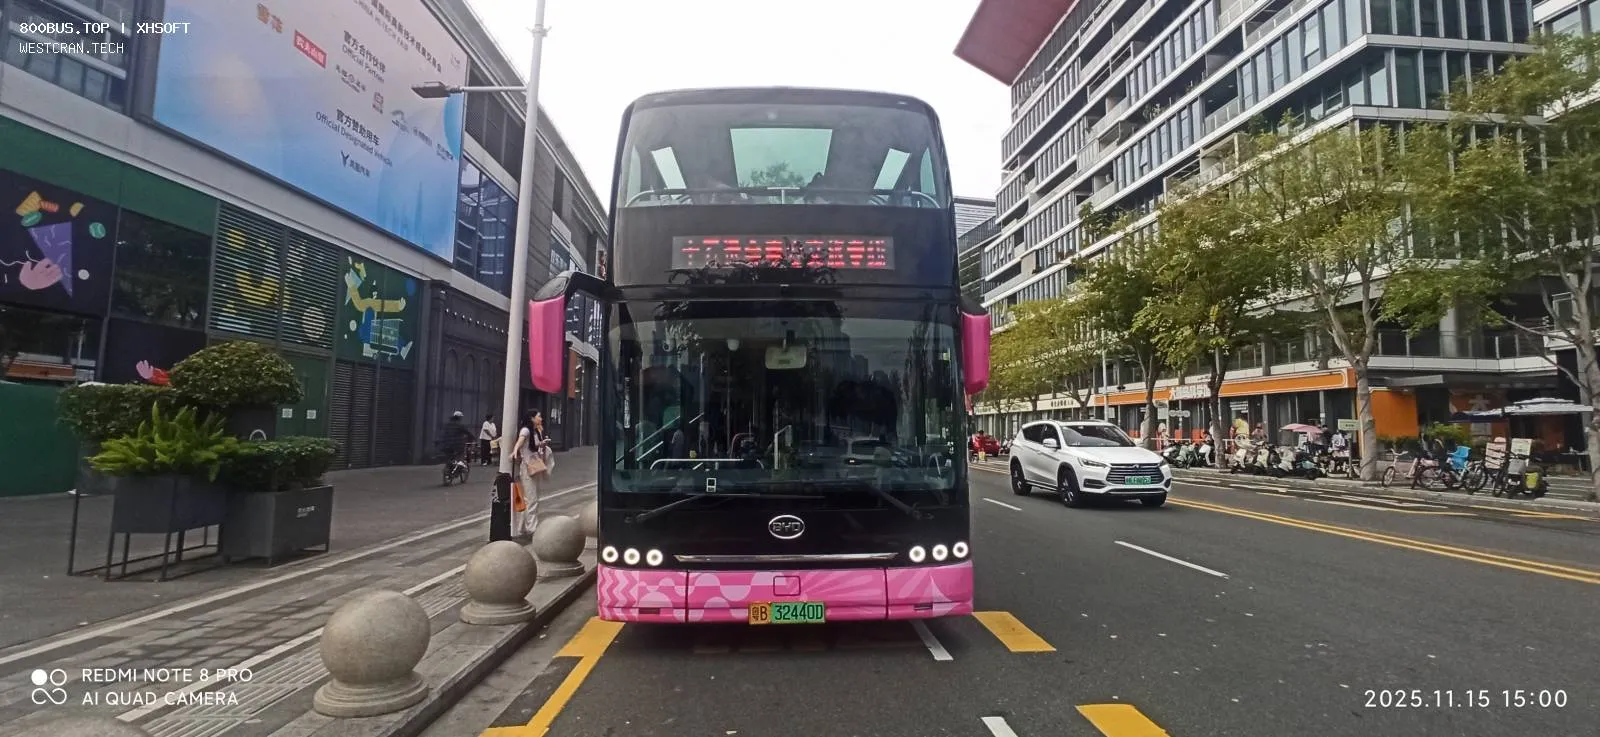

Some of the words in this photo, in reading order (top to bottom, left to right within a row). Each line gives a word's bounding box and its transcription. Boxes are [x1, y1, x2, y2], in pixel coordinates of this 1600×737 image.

[342, 44, 363, 67] Official
[315, 111, 341, 133] Official
[772, 521, 801, 532] BYD
